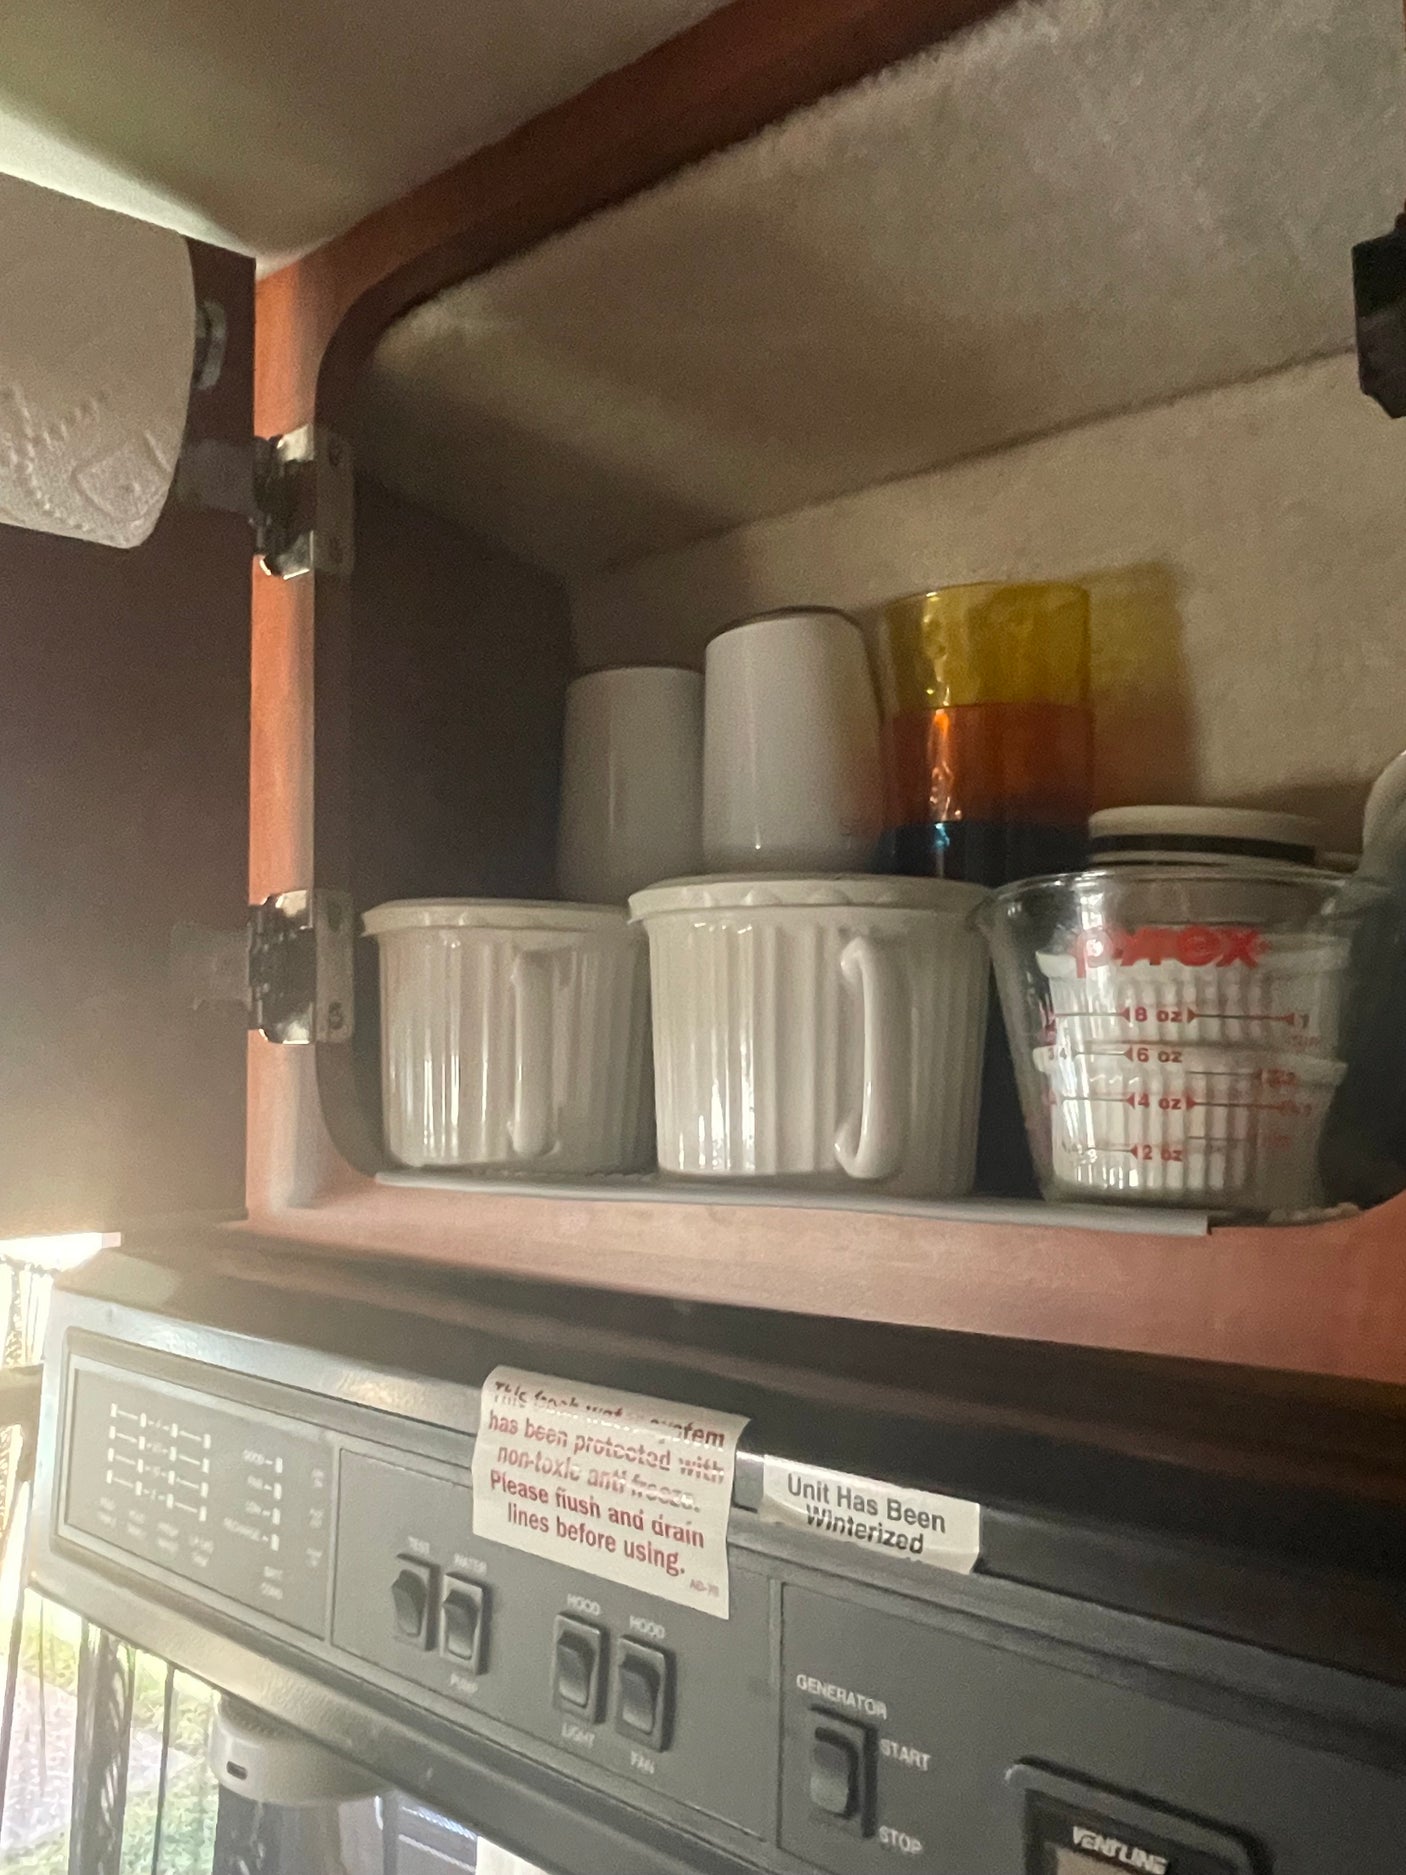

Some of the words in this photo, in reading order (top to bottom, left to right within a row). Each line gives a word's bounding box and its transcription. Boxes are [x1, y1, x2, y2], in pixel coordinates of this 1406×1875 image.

[1135, 1007, 1148, 1023] 8
[1156, 1009, 1183, 1024] oz
[1137, 1047, 1149, 1062] 6
[1157, 1050, 1183, 1064] oz
[1137, 1095, 1150, 1110] 4
[1157, 1097, 1183, 1111] oz
[1141, 1145, 1153, 1160] 2
[488, 1410, 518, 1434] has
[524, 1417, 568, 1446] been
[574, 1433, 671, 1472] protected
[678, 1456, 725, 1484] with
[497, 1446, 580, 1481] non-toxic
[490, 1469, 549, 1504] Please
[555, 1487, 601, 1519] flush
[608, 1507, 645, 1531] and
[651, 1513, 704, 1549] drain
[787, 1472, 830, 1504] Unit
[837, 1485, 879, 1516] Has
[886, 1497, 946, 1534] Been
[507, 1502, 550, 1533] lines
[556, 1517, 617, 1553] before
[623, 1538, 686, 1577] using.
[806, 1503, 924, 1555] Winterized
[567, 1593, 601, 1616] HOOD
[629, 1615, 666, 1640] HOOD
[796, 1674, 888, 1720] GENERATOR
[879, 1738, 932, 1772] START
[879, 1825, 924, 1854] STOP
